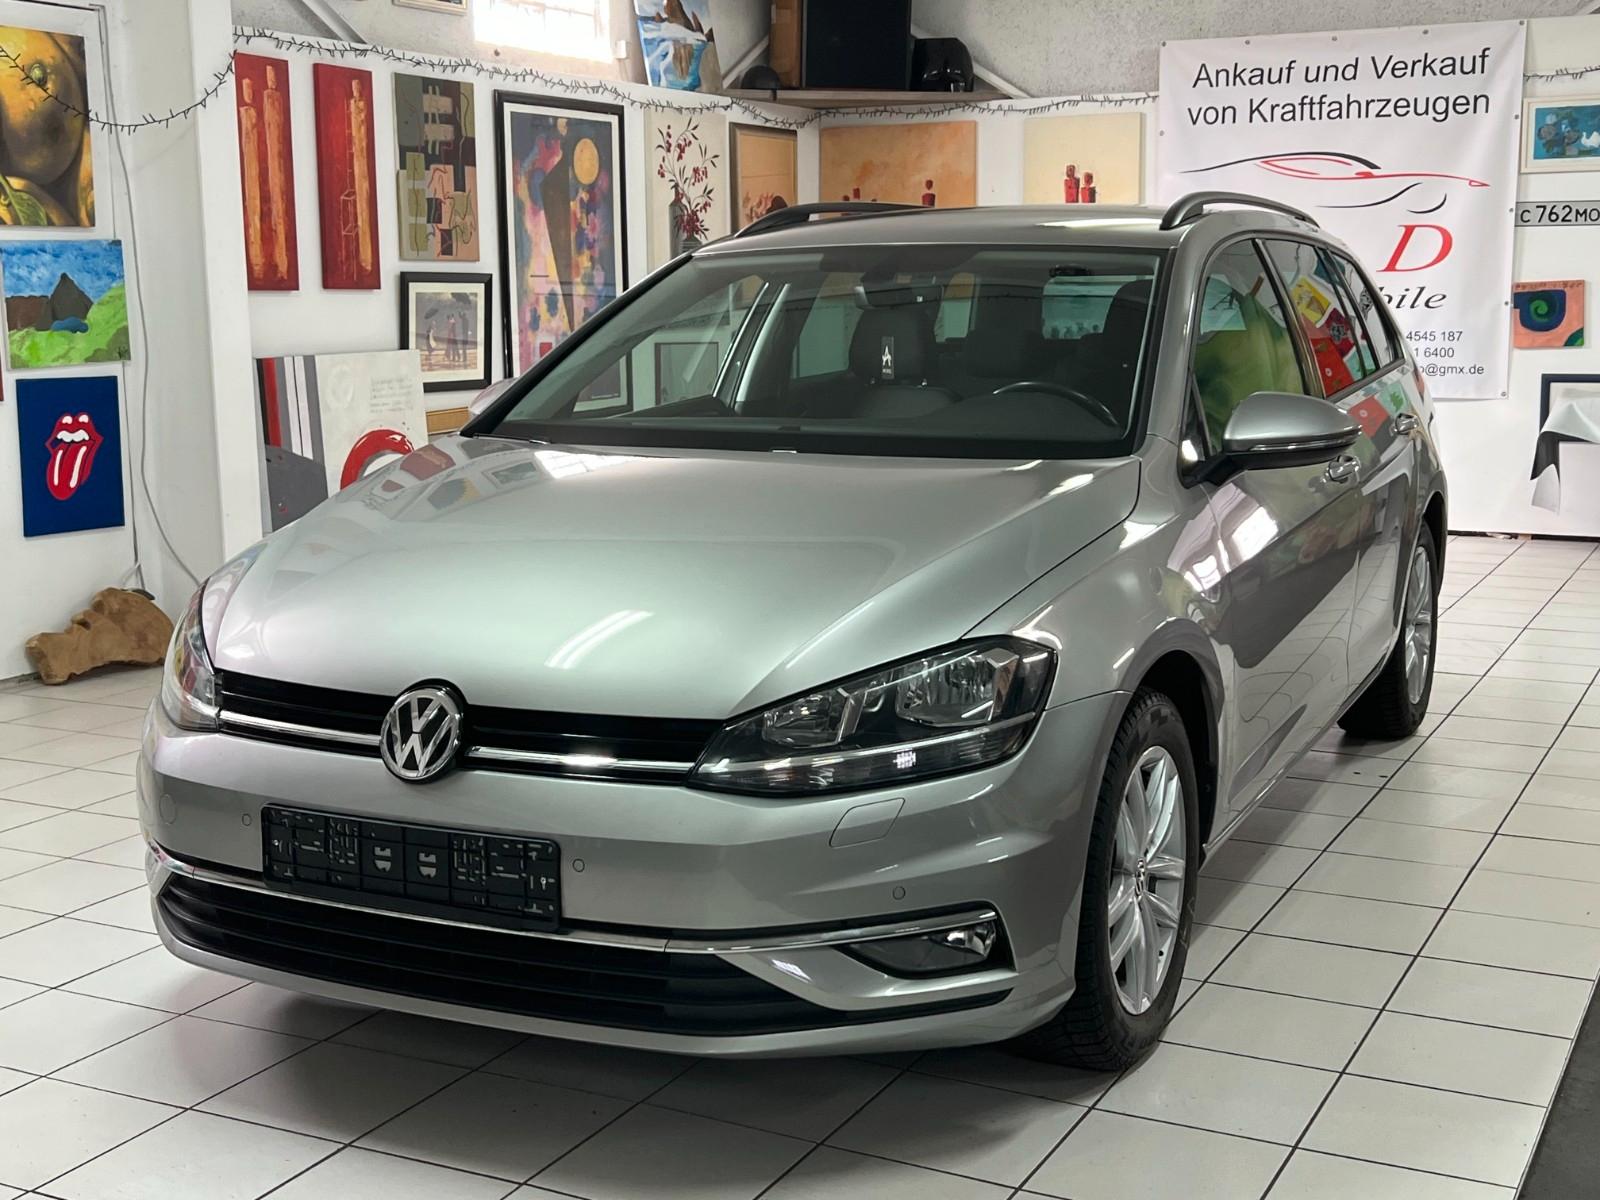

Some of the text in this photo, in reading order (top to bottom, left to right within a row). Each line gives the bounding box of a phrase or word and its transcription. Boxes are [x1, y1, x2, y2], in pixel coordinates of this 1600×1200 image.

[1192, 47, 1491, 88] Ankauf und Verkauf
[1187, 93, 1490, 126] von Kraftfahrzeugen
[1376, 224, 1454, 273] D
[1406, 331, 1463, 342] 4545 187
[1424, 347, 1455, 358] 6400
